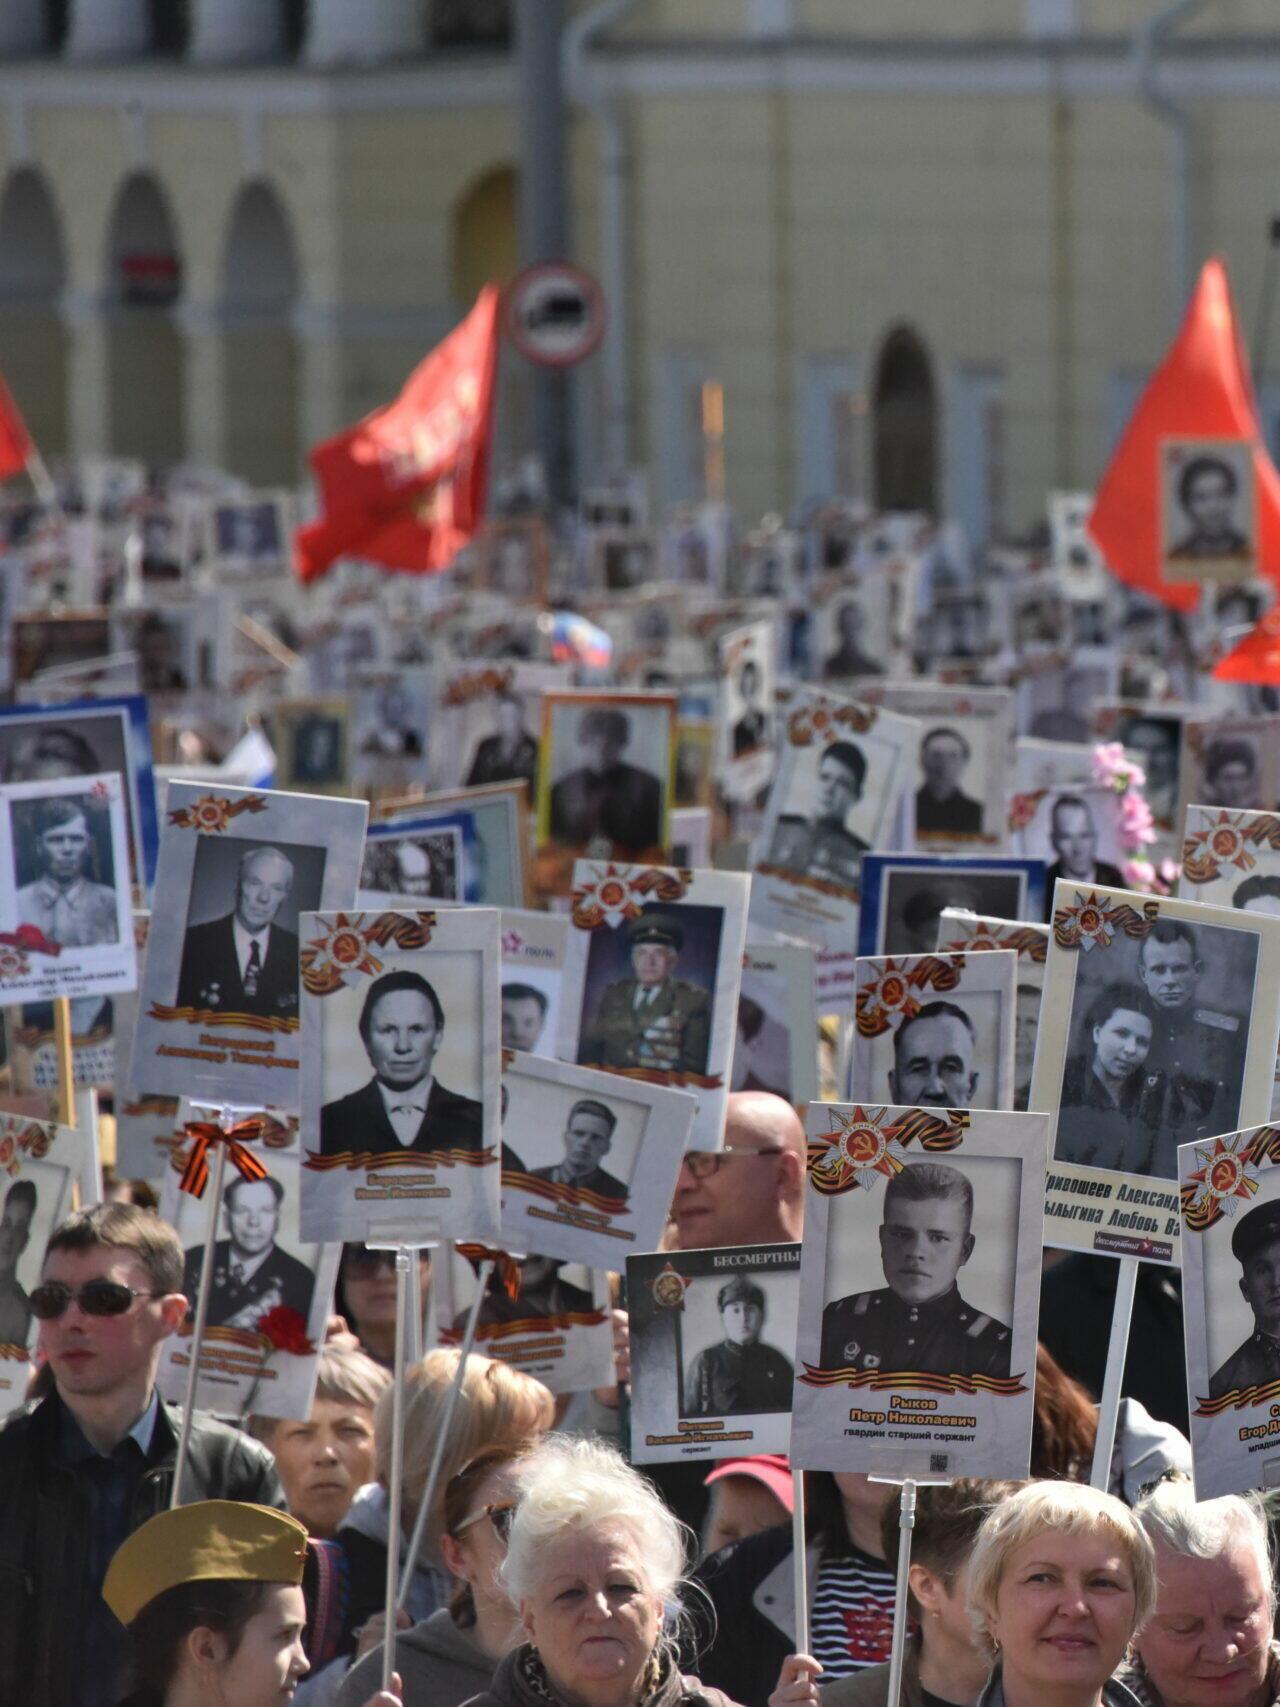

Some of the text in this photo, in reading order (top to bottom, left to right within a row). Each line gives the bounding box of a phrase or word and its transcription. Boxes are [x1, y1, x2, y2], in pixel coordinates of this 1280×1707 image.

[1045, 1171, 1180, 1214] ривошеев Александ
[1044, 1200, 1181, 1236] ылыгина Любовь Ва
[713, 1251, 801, 1267] БЕССМЕРТНЫ
[890, 1395, 937, 1410] Рыков
[849, 1408, 977, 1427] Петр Николаевич
[844, 1427, 976, 1443] гвардии старший сержант
[1239, 1425, 1267, 1441] Егор
